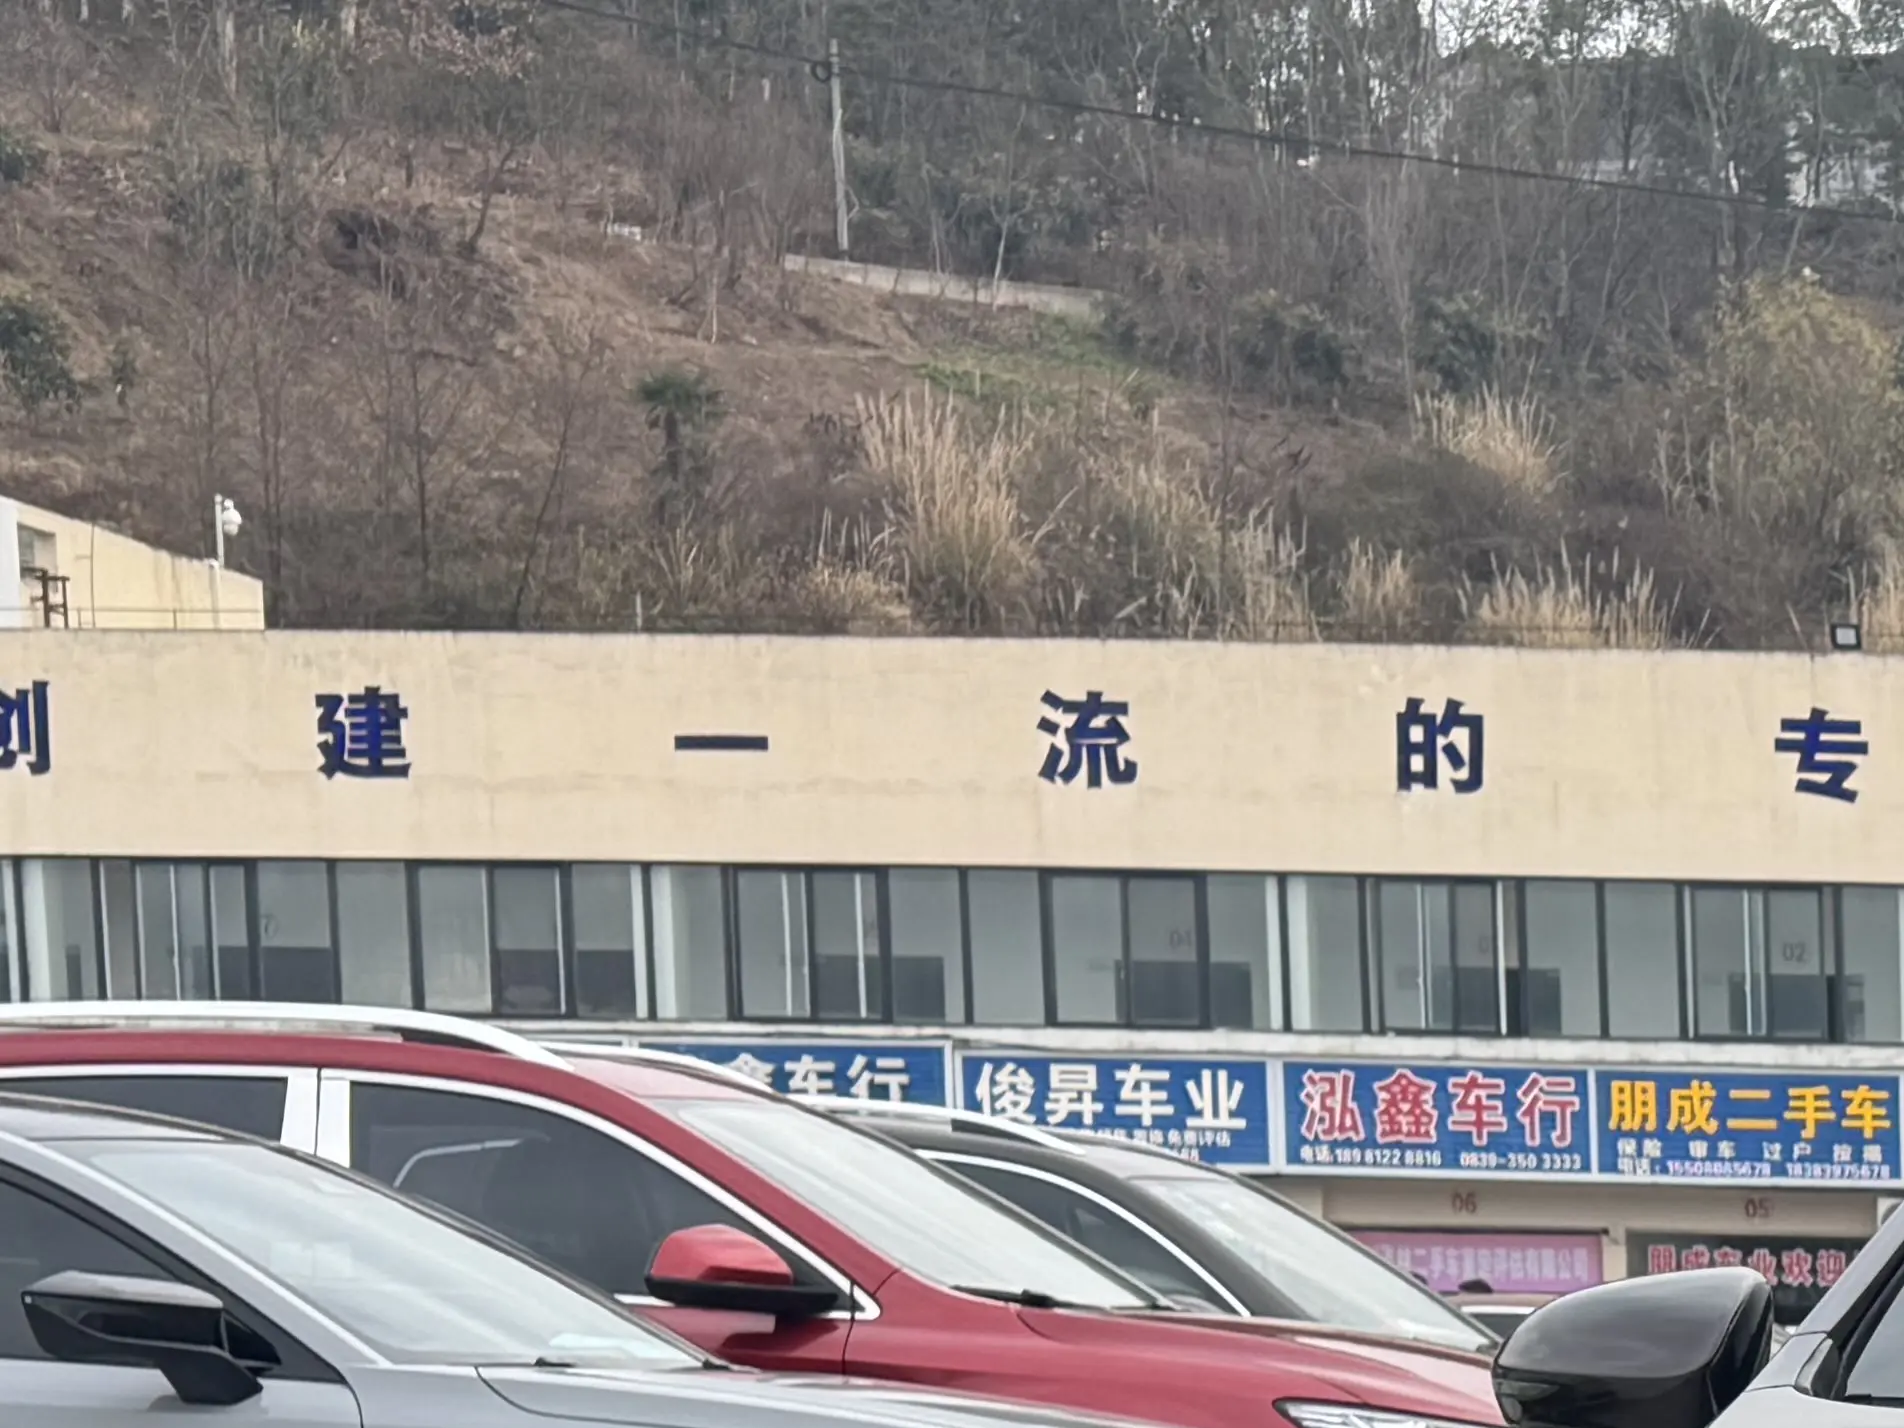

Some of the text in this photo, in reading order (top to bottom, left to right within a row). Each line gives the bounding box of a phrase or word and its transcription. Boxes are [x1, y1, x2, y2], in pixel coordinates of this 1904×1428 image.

[1300, 1067, 1581, 1149] 泓鑫车行
[1608, 1078, 1892, 1140] 朋成二手车
[1451, 1192, 1477, 1215] 06
[1744, 1198, 1770, 1219] 05
